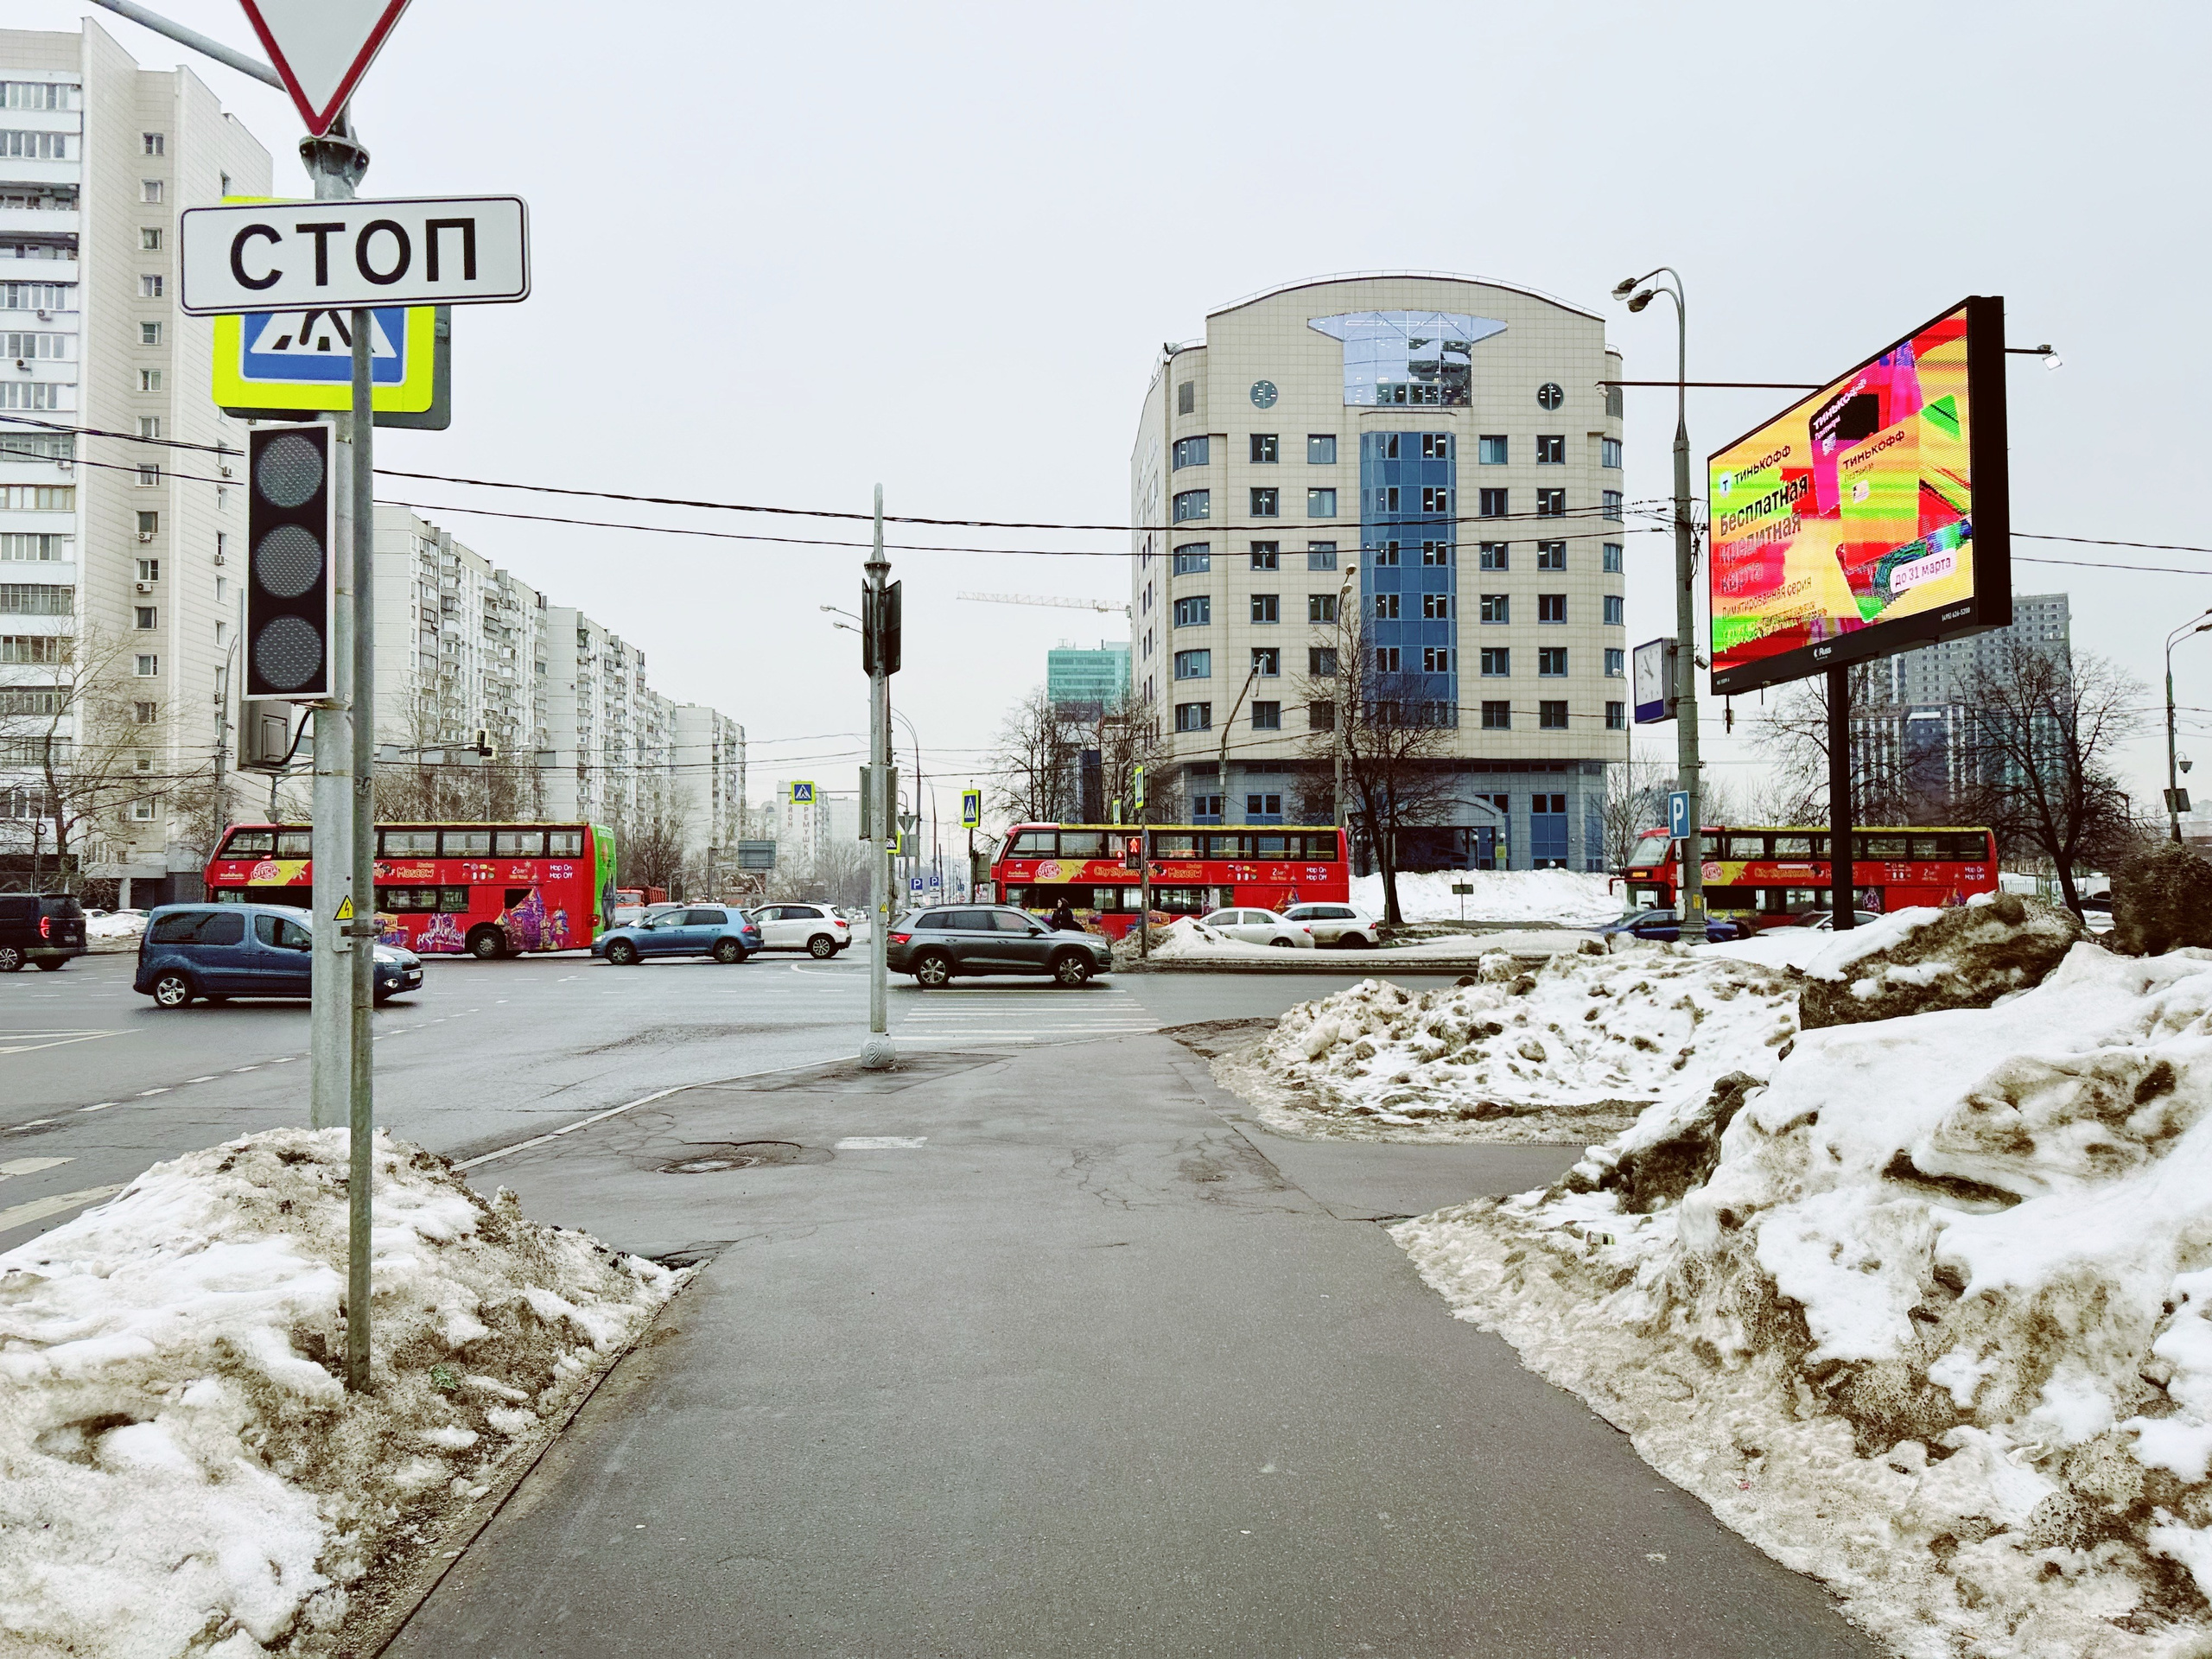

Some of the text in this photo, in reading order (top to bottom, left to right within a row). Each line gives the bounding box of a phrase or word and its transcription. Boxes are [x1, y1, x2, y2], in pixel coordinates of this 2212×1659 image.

[230, 218, 477, 291] СТОП
[1734, 446, 1791, 485] ТИНЬКОФФ
[1843, 430, 1904, 469] ТИНЬКОФФ
[1720, 475, 1808, 537] Бесплатная
[1896, 557, 1951, 588] до 31 марта
[1673, 797, 1684, 834] P
[913, 879, 921, 889] P
